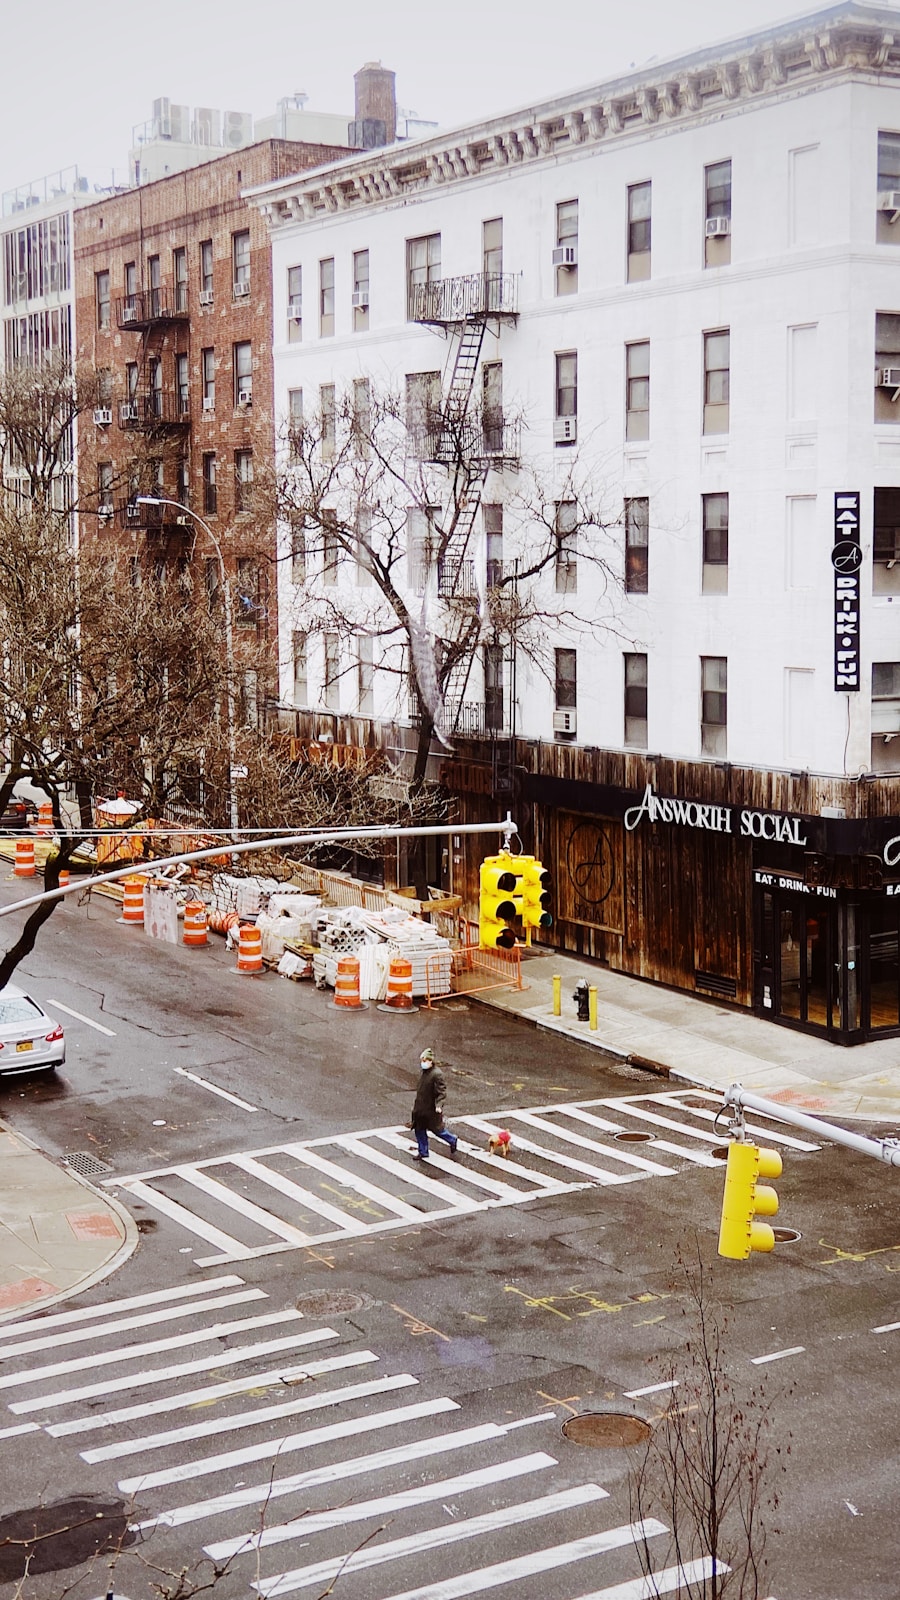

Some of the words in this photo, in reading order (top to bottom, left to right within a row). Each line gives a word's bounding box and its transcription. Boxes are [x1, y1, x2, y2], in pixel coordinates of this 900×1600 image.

[836, 496, 858, 535] EAT
[836, 577, 858, 634] DRINK
[836, 650, 858, 686] FUN
[624, 783, 732, 833] AINSWORTH
[740, 810, 807, 846] SOCIAL
[755, 872, 773, 885] EAT
[816, 885, 837, 898] FUN
